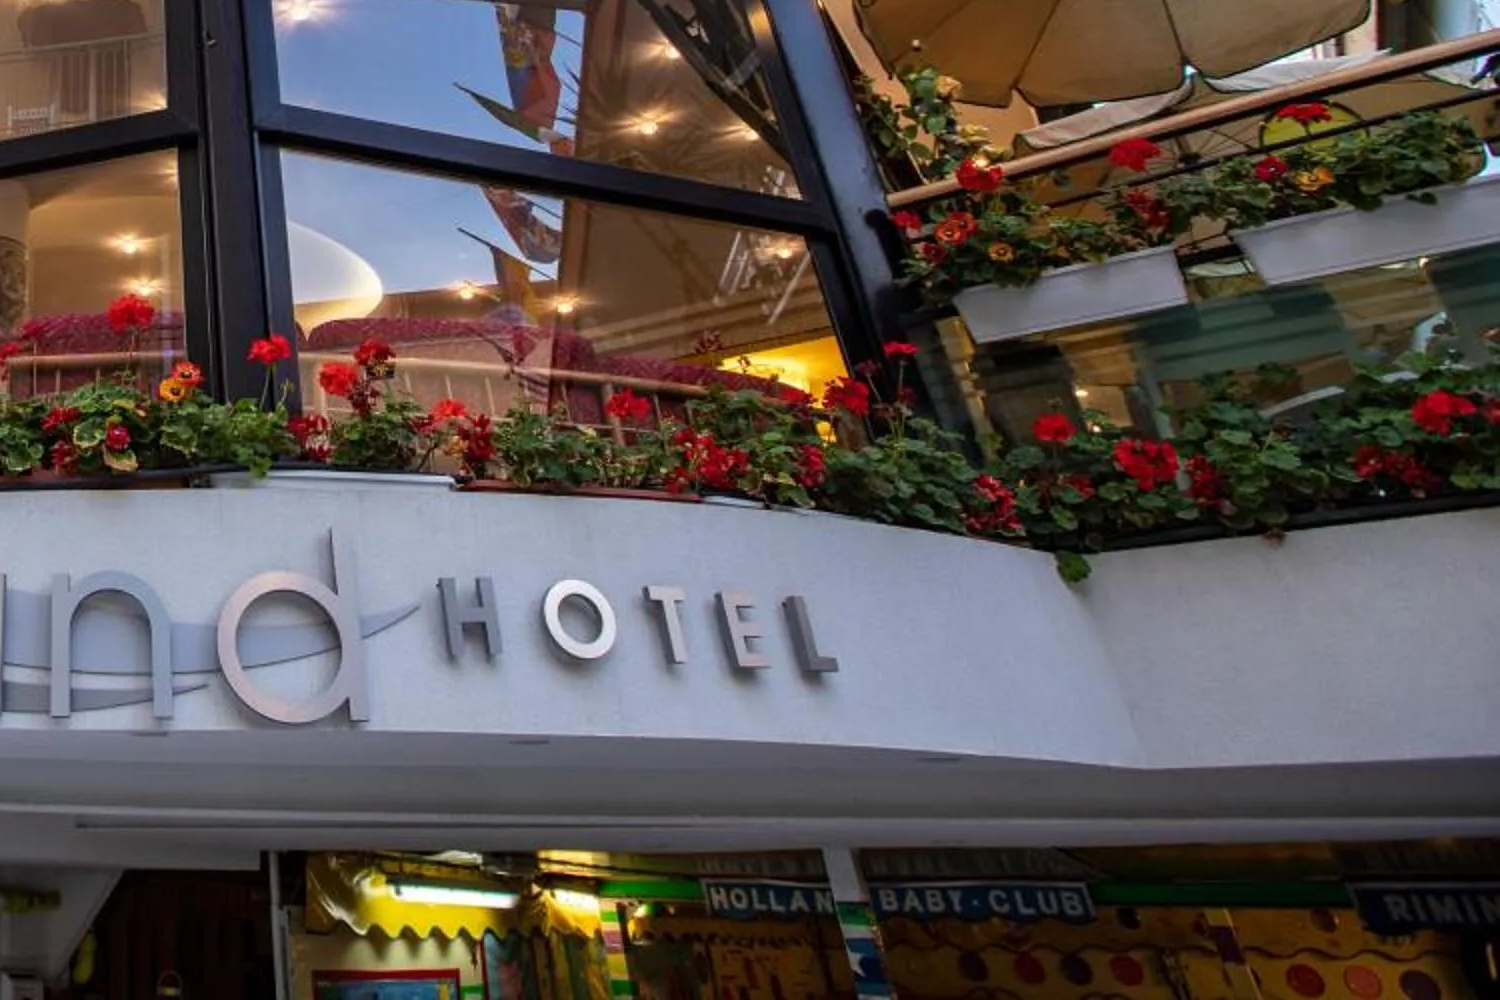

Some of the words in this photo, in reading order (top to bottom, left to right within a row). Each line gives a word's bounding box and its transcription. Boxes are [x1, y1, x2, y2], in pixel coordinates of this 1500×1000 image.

[437, 576, 840, 674] HOTEL
[710, 887, 836, 914] HOLLAN
[880, 888, 966, 914] BABY
[988, 888, 1086, 917] CLUB
